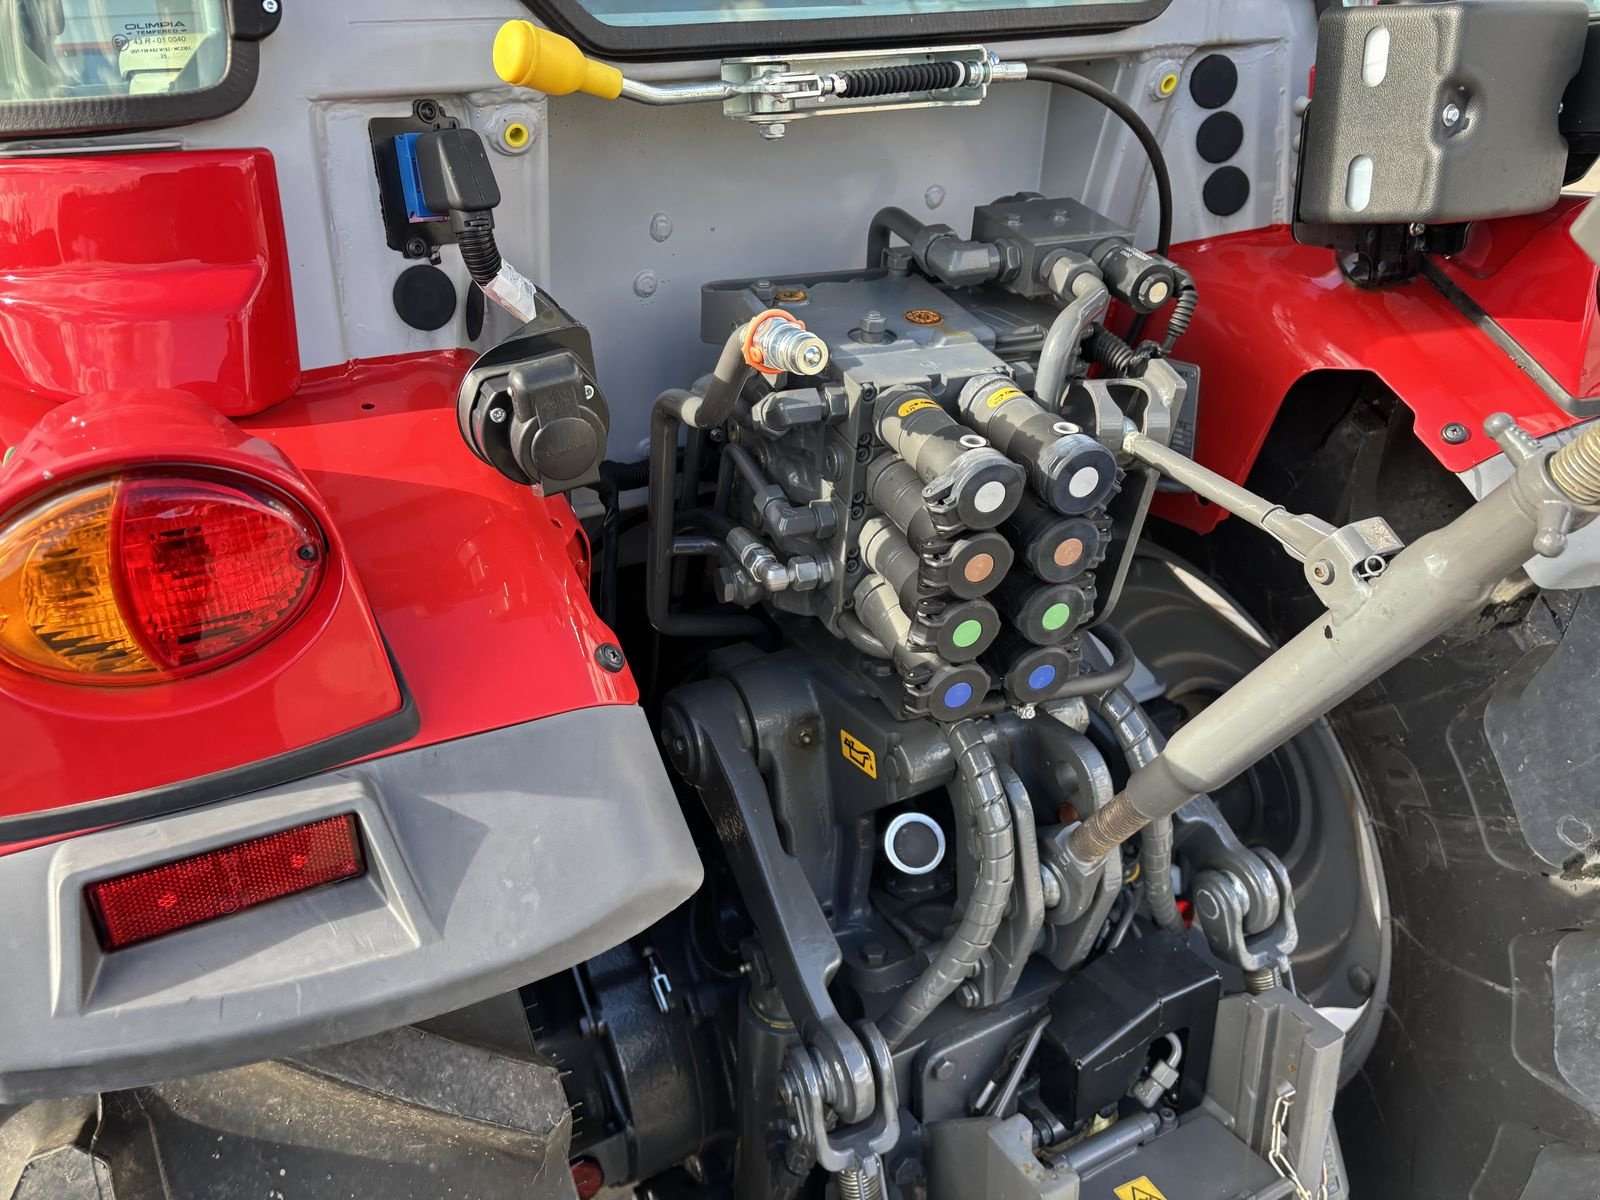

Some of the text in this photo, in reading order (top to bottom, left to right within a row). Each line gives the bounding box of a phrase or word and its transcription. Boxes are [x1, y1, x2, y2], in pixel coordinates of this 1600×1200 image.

[125, 20, 186, 30] OLIMPIA
[136, 28, 178, 36] TEMPERED
[145, 37, 151, 45] R
